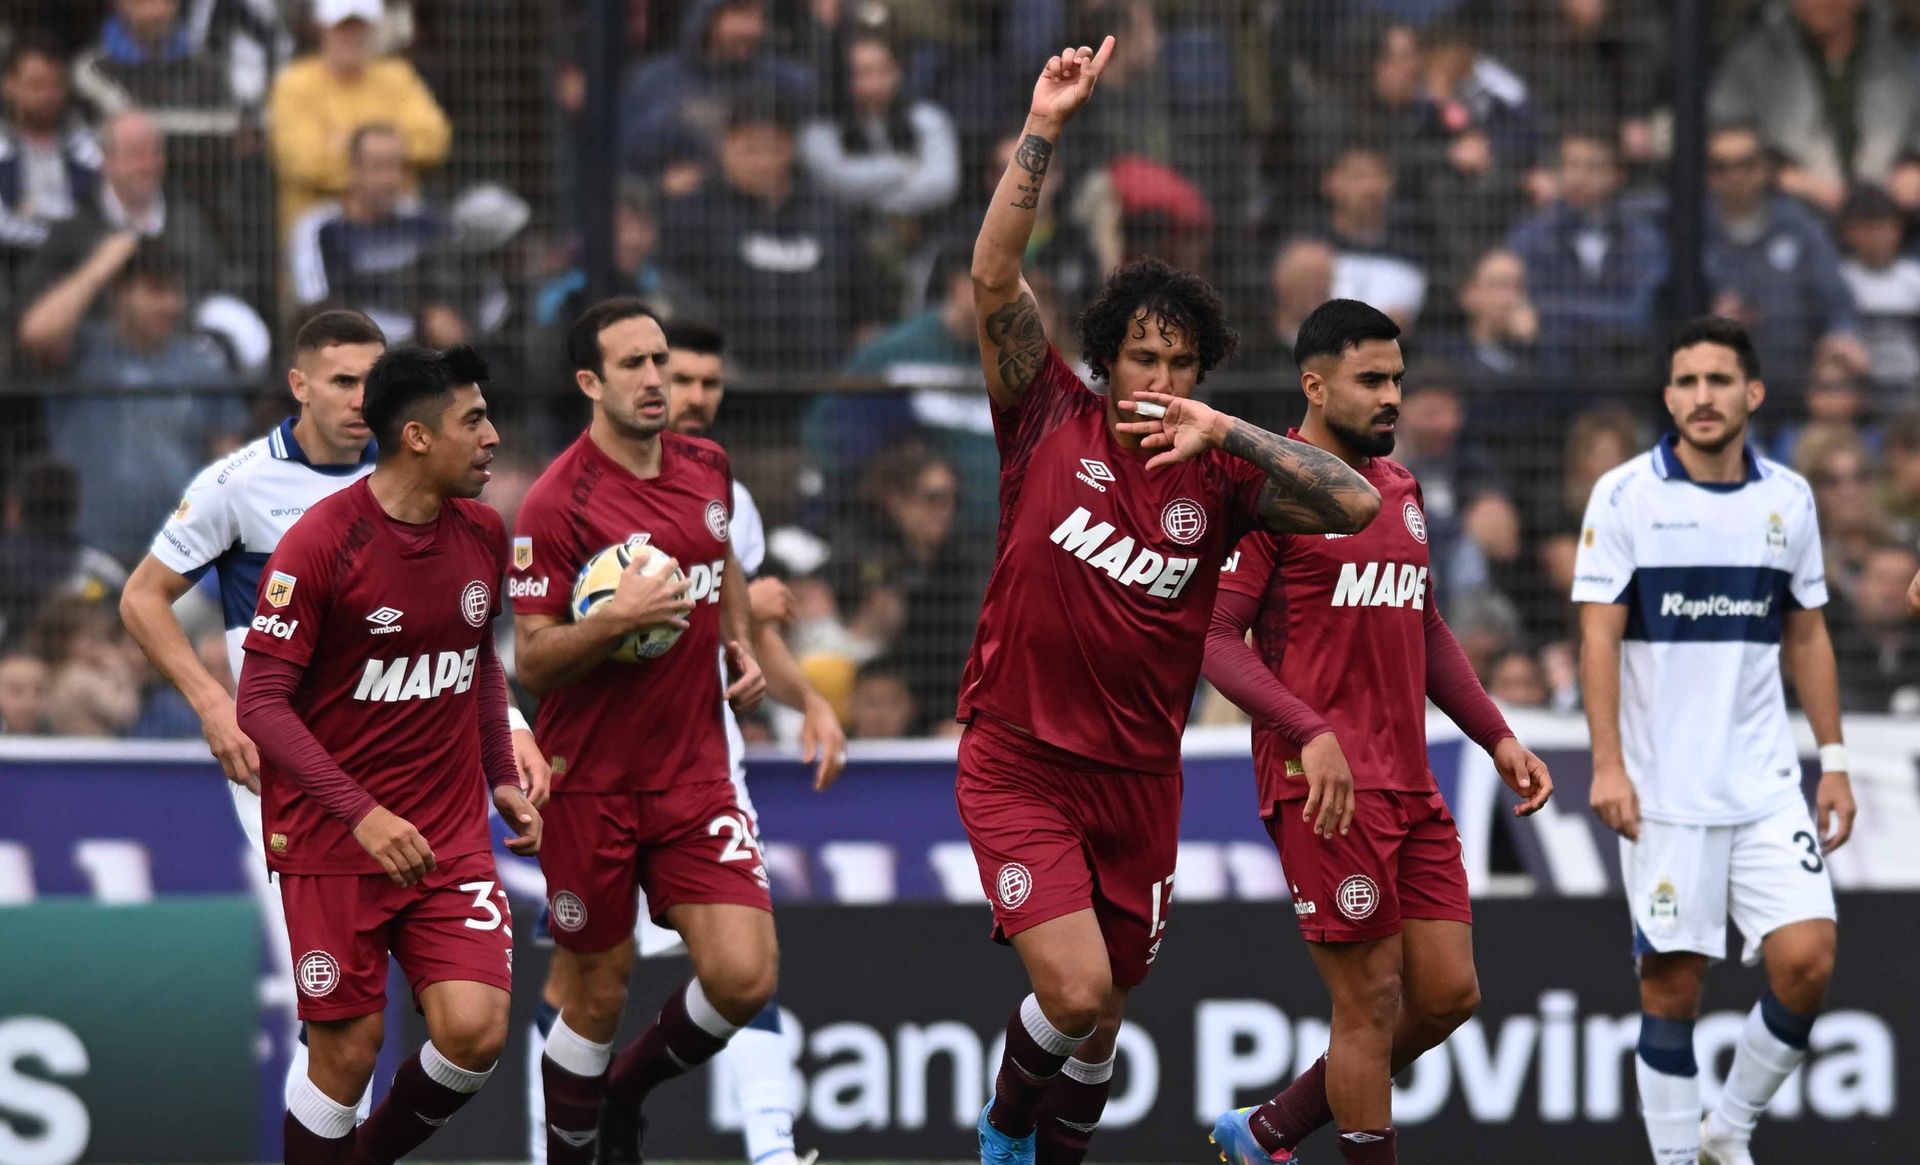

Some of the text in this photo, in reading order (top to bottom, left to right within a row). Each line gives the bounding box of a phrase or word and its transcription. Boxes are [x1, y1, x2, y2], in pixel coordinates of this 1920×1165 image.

[1076, 471, 1106, 493] umbro
[1050, 506, 1198, 599] MAPEI
[508, 576, 549, 597] Befol
[370, 625, 402, 635] umbro
[1793, 830, 1823, 874] 3
